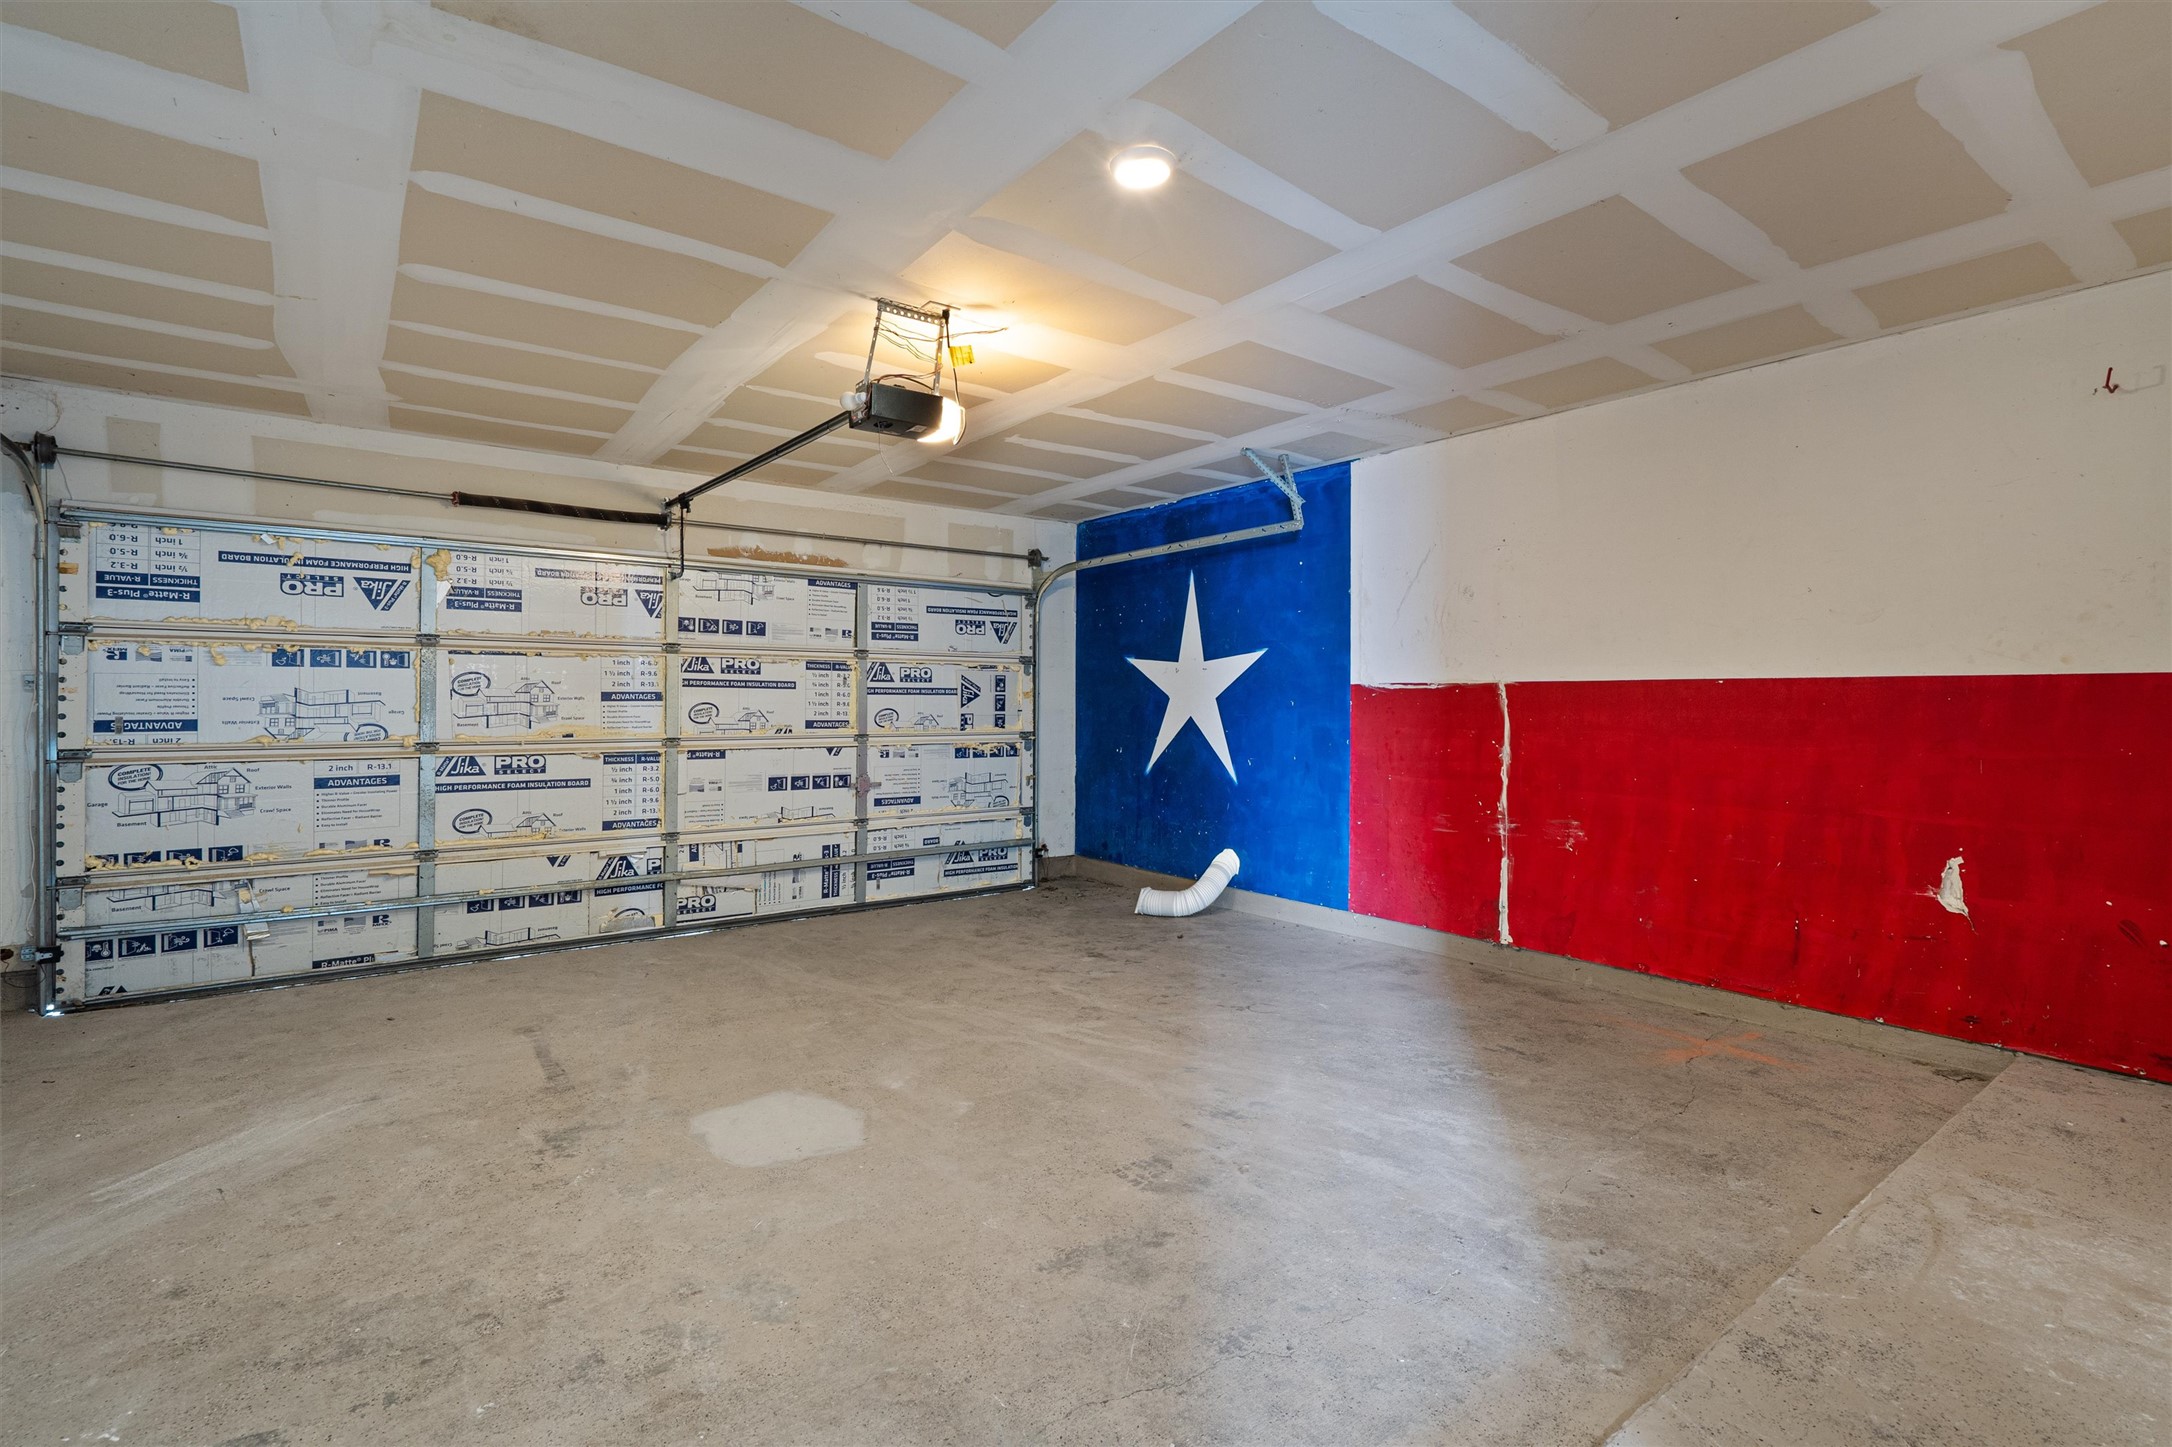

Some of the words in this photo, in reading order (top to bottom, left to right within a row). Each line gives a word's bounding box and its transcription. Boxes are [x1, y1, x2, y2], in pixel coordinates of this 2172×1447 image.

[109, 534, 138, 542] R-6.0
[155, 537, 176, 546] inch
[109, 548, 138, 556] R-5.0
[155, 550, 176, 559] inch
[221, 554, 252, 562] BOARD
[253, 555, 304, 566] INULATION
[110, 562, 138, 570] R-3.2
[306, 559, 328, 567] FOAM
[330, 560, 388, 570] PERFORMANCE
[155, 564, 176, 573] inch
[104, 574, 141, 582] R-VALUE
[152, 577, 198, 586] THICKNESS
[280, 580, 344, 597] PRO
[816, 580, 851, 588] ADVANTAGES
[107, 588, 140, 598] Plus-3
[360, 580, 392, 600] Sika
[487, 590, 520, 598] THICKNESS
[580, 592, 628, 607] PRO
[955, 624, 986, 636] PRO
[720, 657, 761, 670] PRO
[900, 666, 932, 678] PRO
[110, 722, 182, 730] ADVANTAGS
[494, 754, 546, 769] PRO
[118, 767, 151, 776] COMPLETE
[328, 778, 388, 786] ADVANTAGES
[454, 782, 506, 790] PERFORMANCE
[612, 820, 657, 829] ADVANTAGES
[978, 848, 1008, 858] PRO
[611, 860, 635, 878] Sika
[956, 867, 985, 875] PERFORMANCE
[612, 884, 656, 893] PERFORMANCE
[677, 894, 716, 909] PRO
